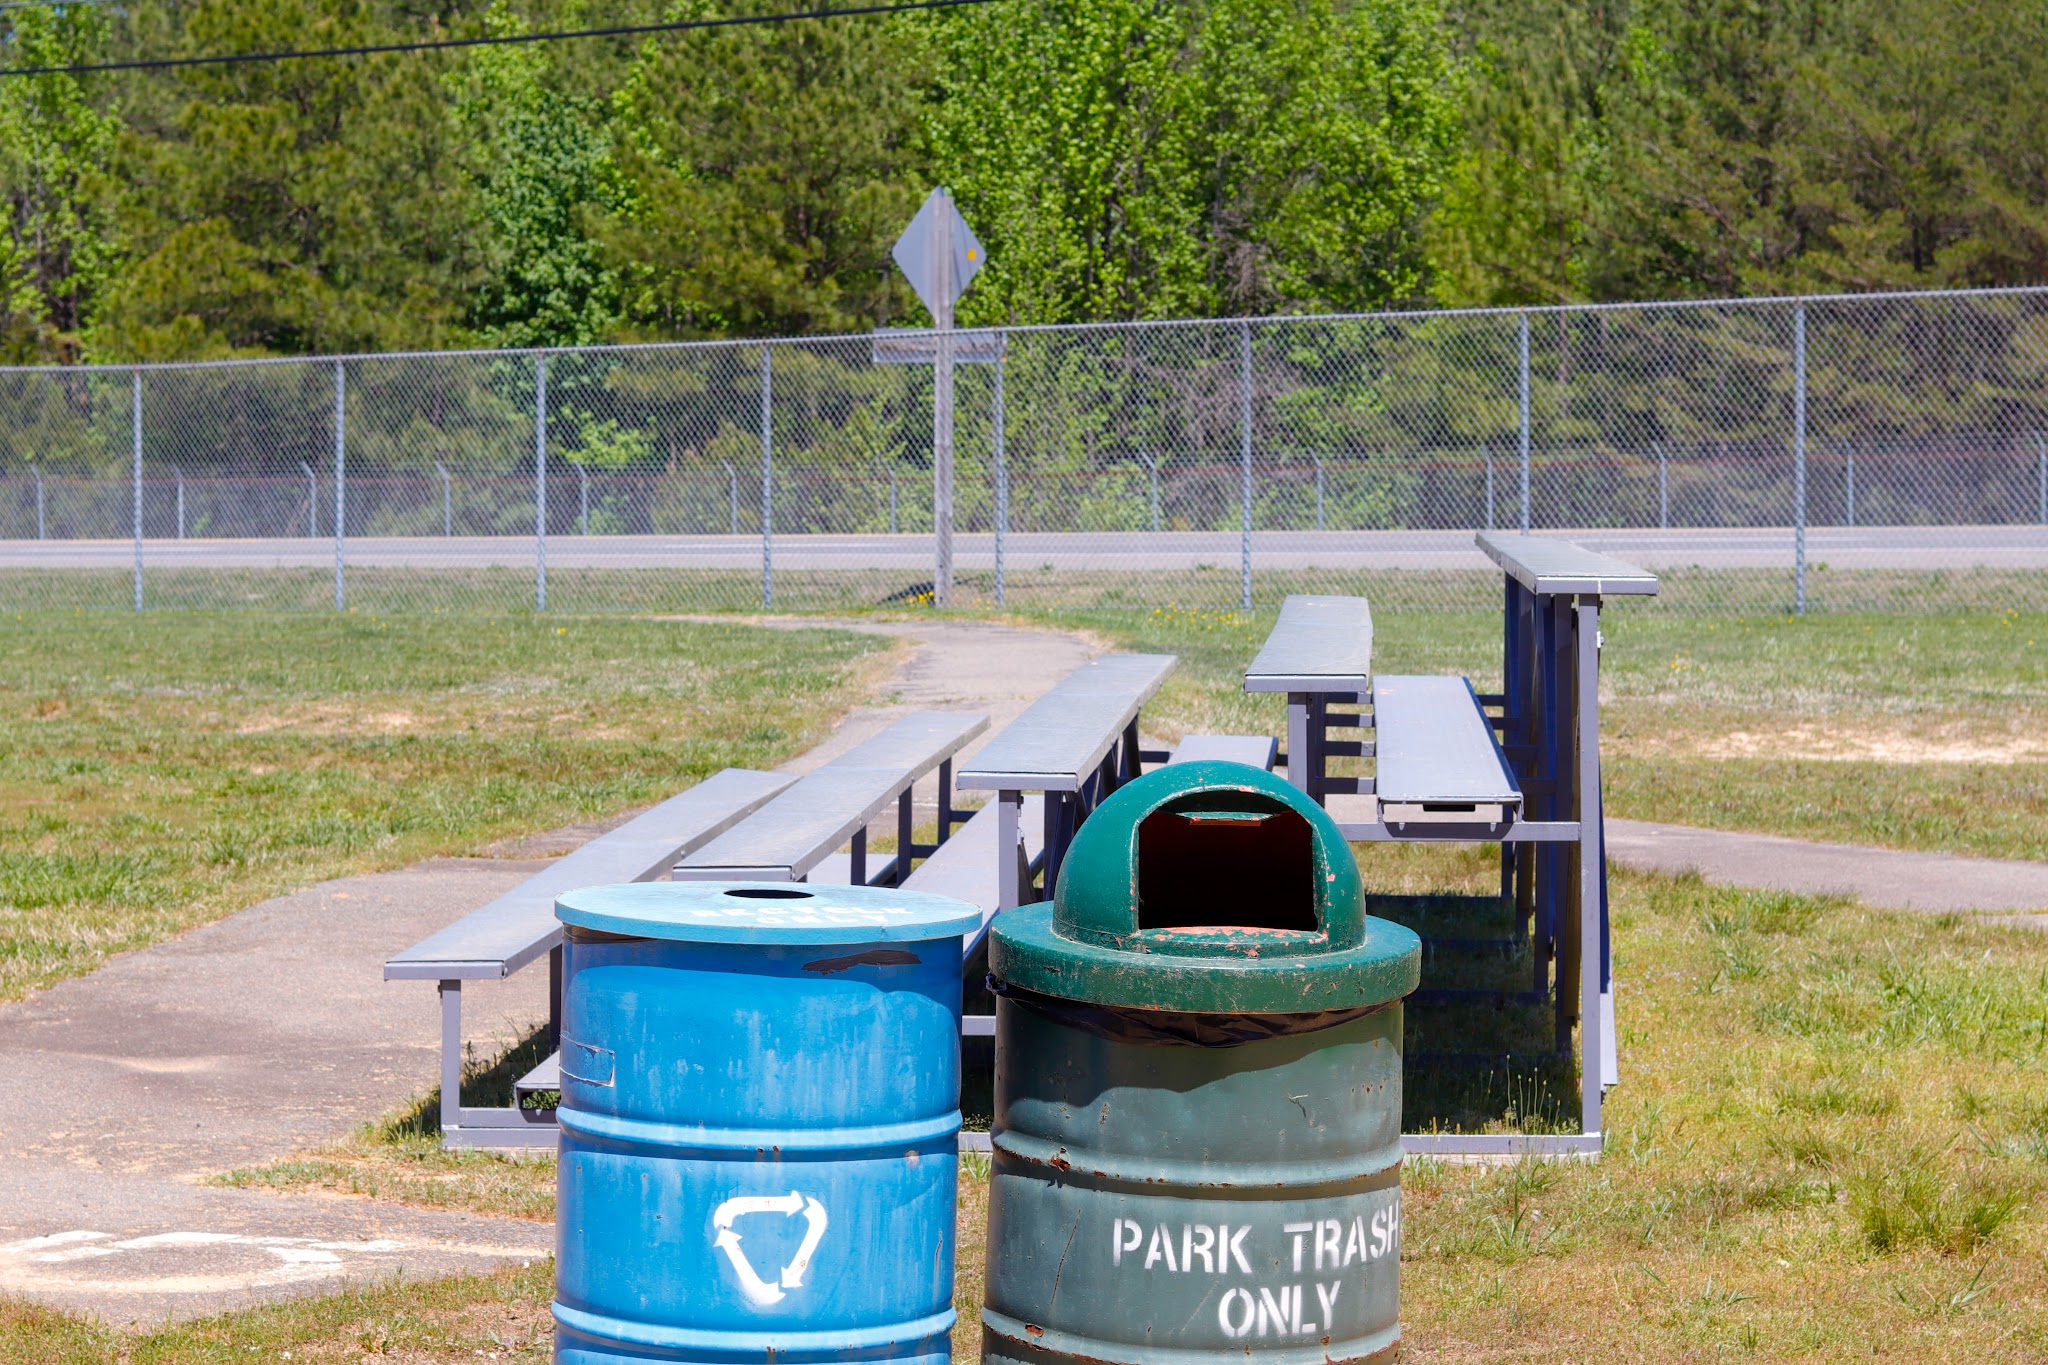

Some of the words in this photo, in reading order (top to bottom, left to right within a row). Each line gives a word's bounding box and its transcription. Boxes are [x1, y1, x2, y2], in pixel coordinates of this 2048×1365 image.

[755, 915, 888, 924] ONLY
[1112, 1217, 1253, 1274] PARK
[1283, 1200, 1400, 1273] TRASH
[1218, 1281, 1342, 1338] ONLY
